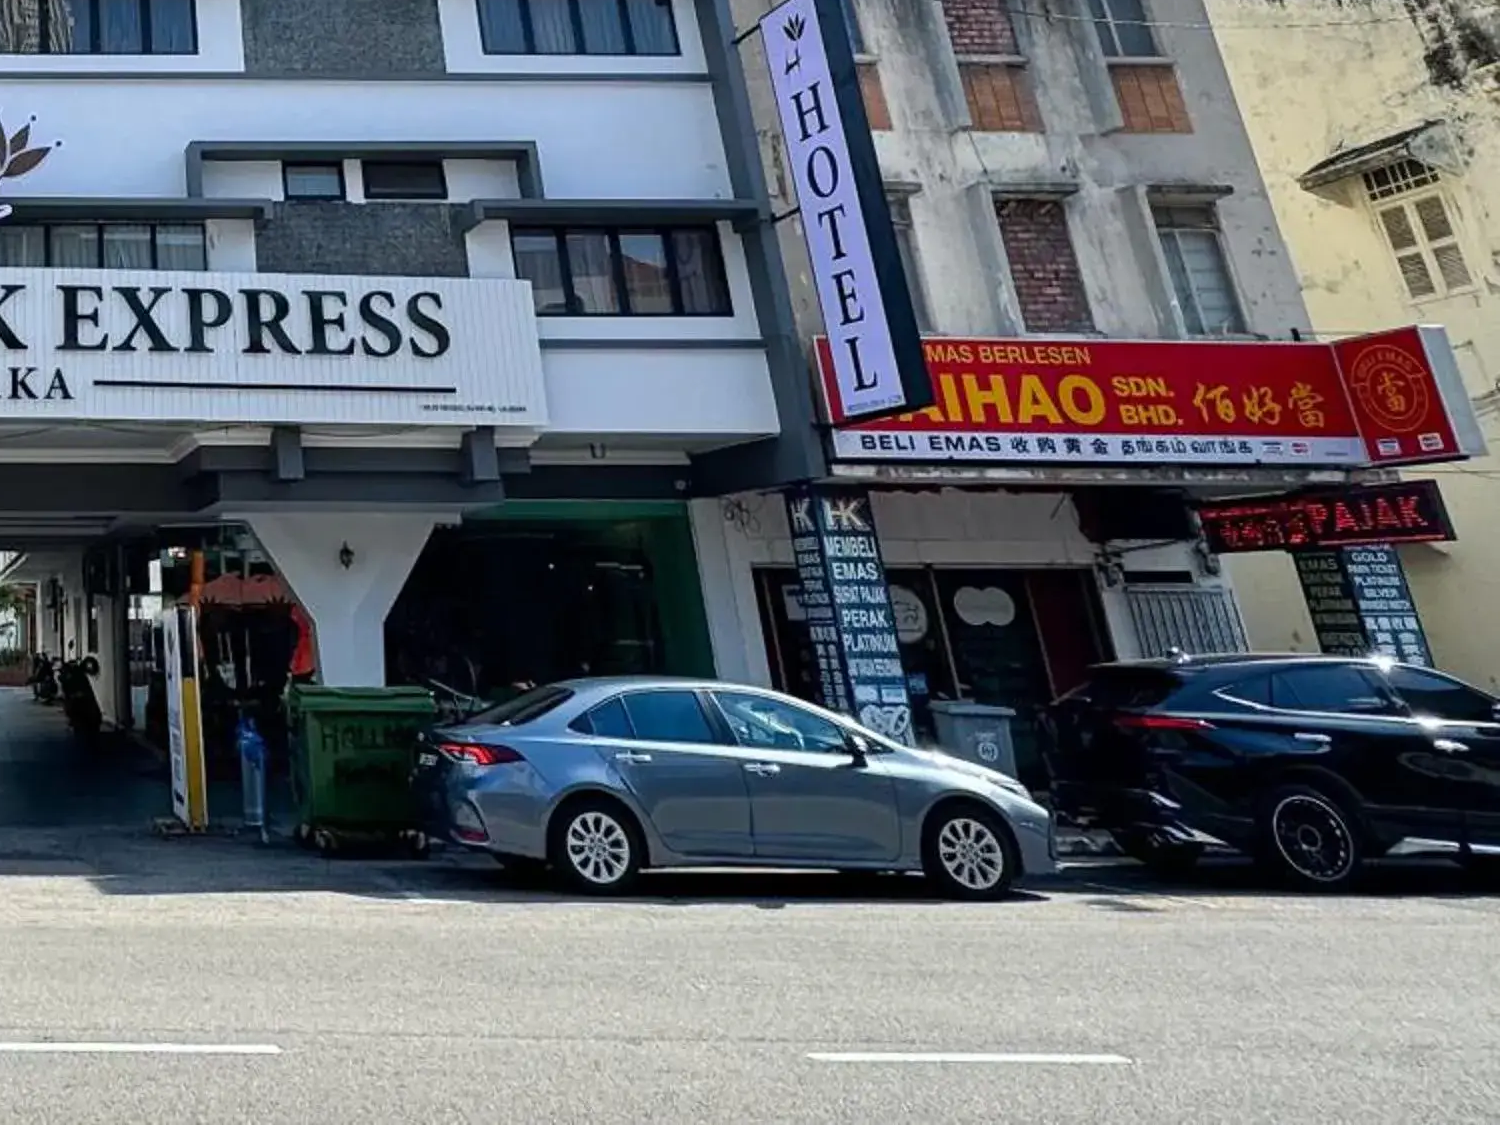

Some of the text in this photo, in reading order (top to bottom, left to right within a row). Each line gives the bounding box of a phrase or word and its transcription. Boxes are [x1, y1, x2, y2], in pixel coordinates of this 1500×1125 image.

[791, 80, 878, 393] HOTEL
[55, 285, 451, 358] EXPRESS
[923, 345, 1092, 366] MAS BERLESEN
[1111, 376, 1175, 398] SDN.
[1120, 403, 1185, 426] BHD.
[861, 435, 1001, 452] BELI EMAS
[1307, 496, 1429, 535] PAJAK
[1351, 552, 1388, 563] GOLD
[831, 562, 879, 580] EMAS
[842, 609, 890, 628] PERAK
